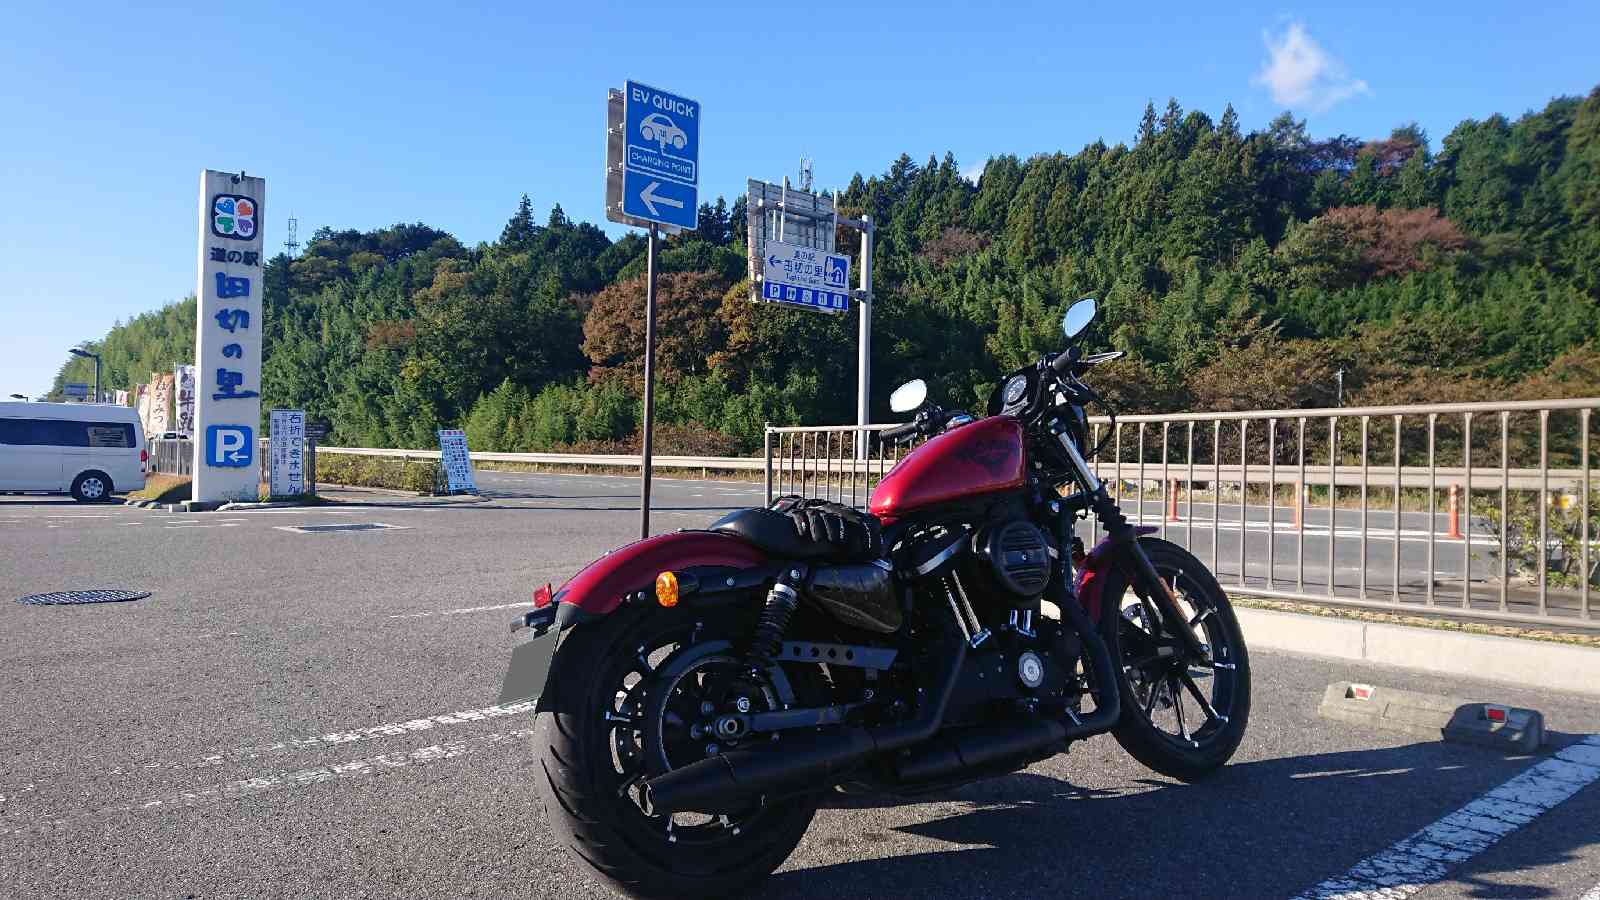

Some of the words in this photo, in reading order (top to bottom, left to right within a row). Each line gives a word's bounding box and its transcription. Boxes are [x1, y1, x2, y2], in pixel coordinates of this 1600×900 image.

[632, 87, 650, 104] EV
[652, 94, 694, 118] QUICK
[631, 152, 670, 169] CHARGING
[671, 162, 691, 178] POINT
[210, 247, 259, 267] 道の駅
[215, 429, 245, 463] P
